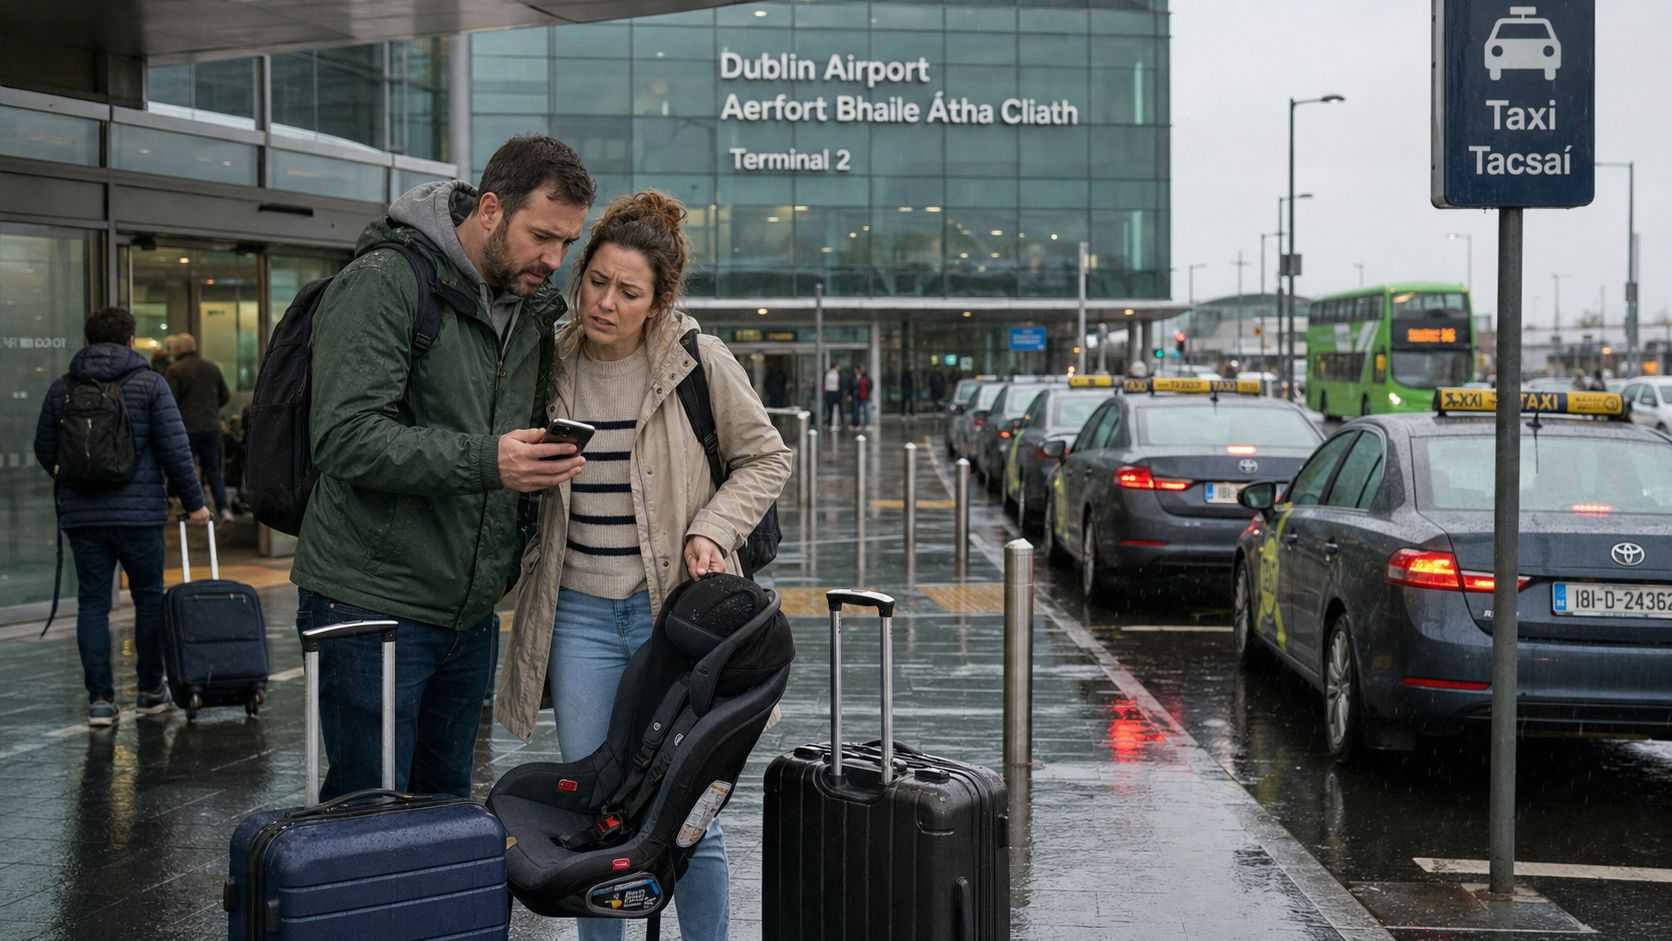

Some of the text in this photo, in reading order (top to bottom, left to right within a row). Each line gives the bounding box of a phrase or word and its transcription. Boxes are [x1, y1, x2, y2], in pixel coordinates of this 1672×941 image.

[720, 52, 930, 88] Dublin Airport
[720, 91, 1078, 126] Aerfort Bhaile Átha Cliath
[1486, 99, 1556, 130] Taxi
[729, 148, 851, 171] Terminal 2
[1468, 145, 1573, 175] Tacsaí
[1520, 392, 1558, 410] TAXI
